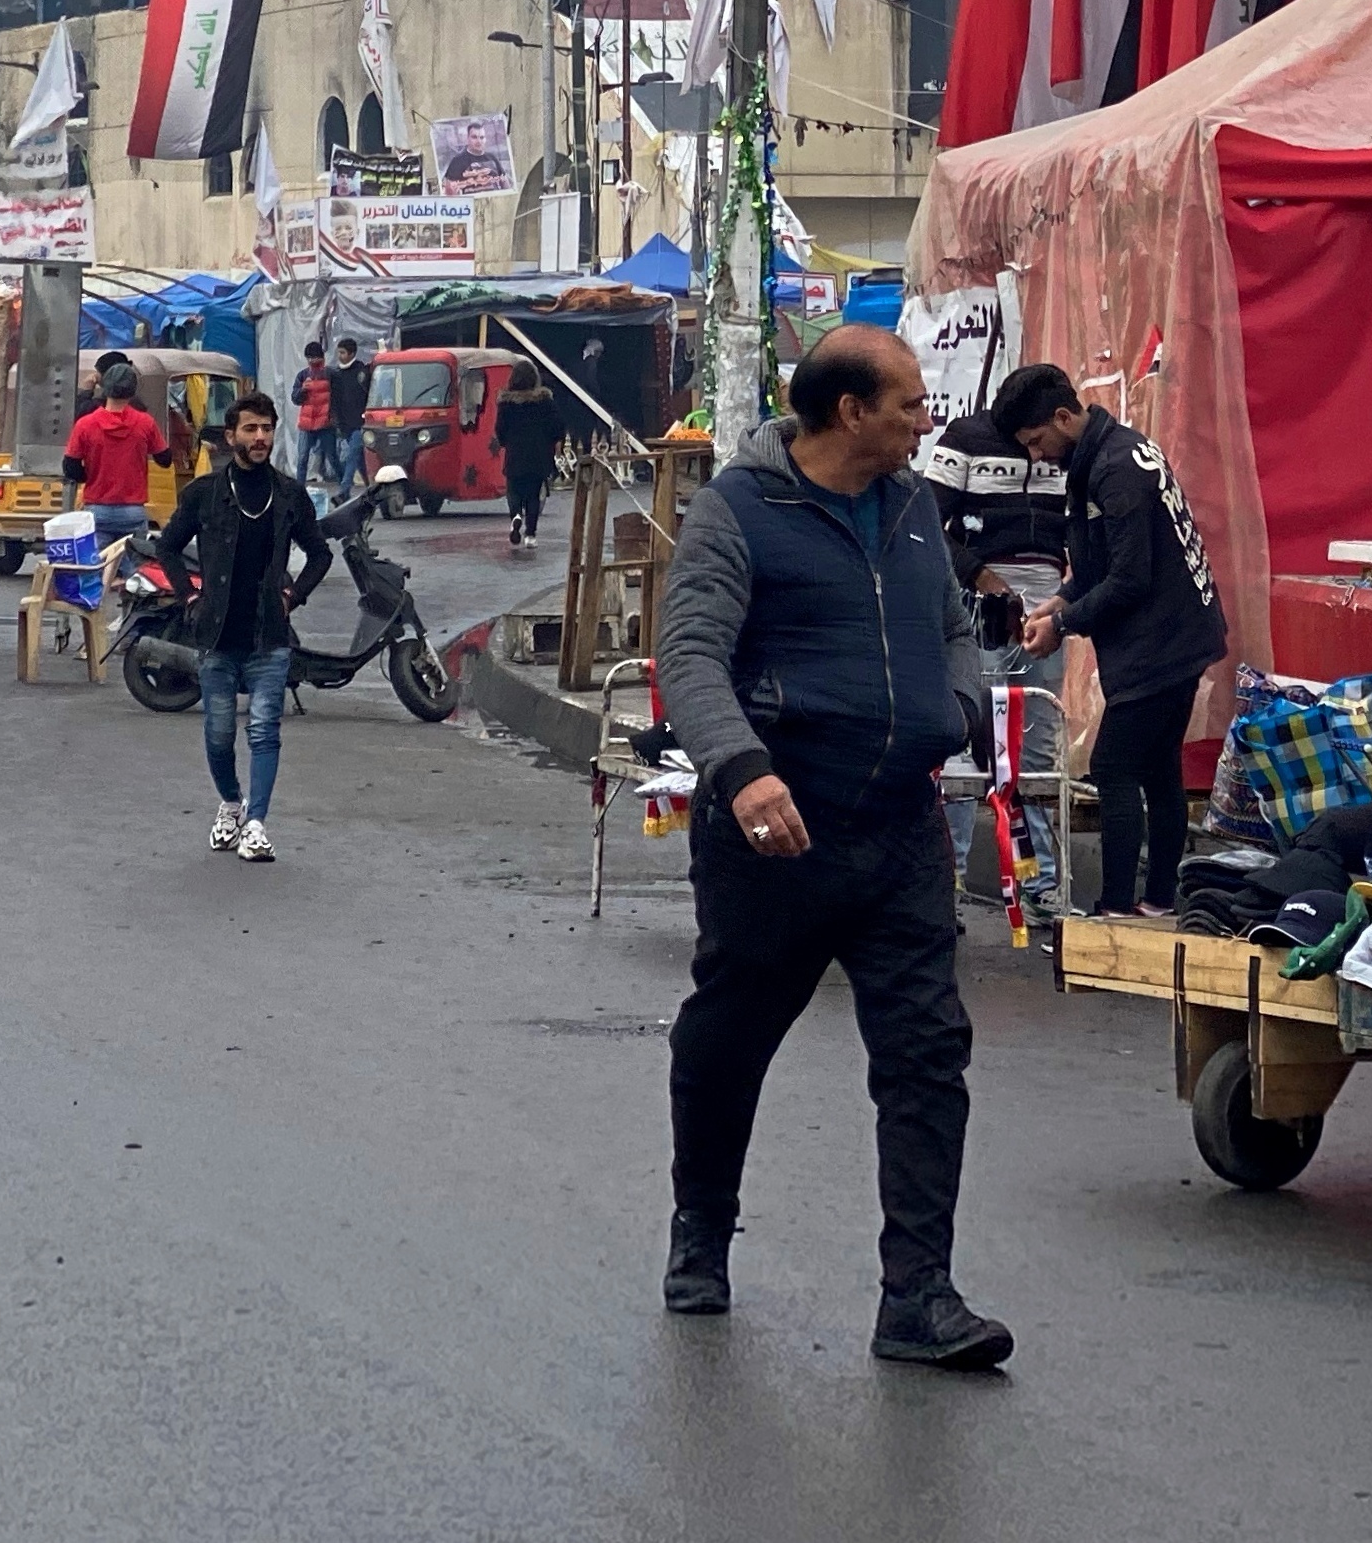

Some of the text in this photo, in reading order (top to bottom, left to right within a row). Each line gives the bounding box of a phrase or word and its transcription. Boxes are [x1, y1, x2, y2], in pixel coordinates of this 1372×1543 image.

[362, 201, 471, 220] خيمة أطفال التحرير
